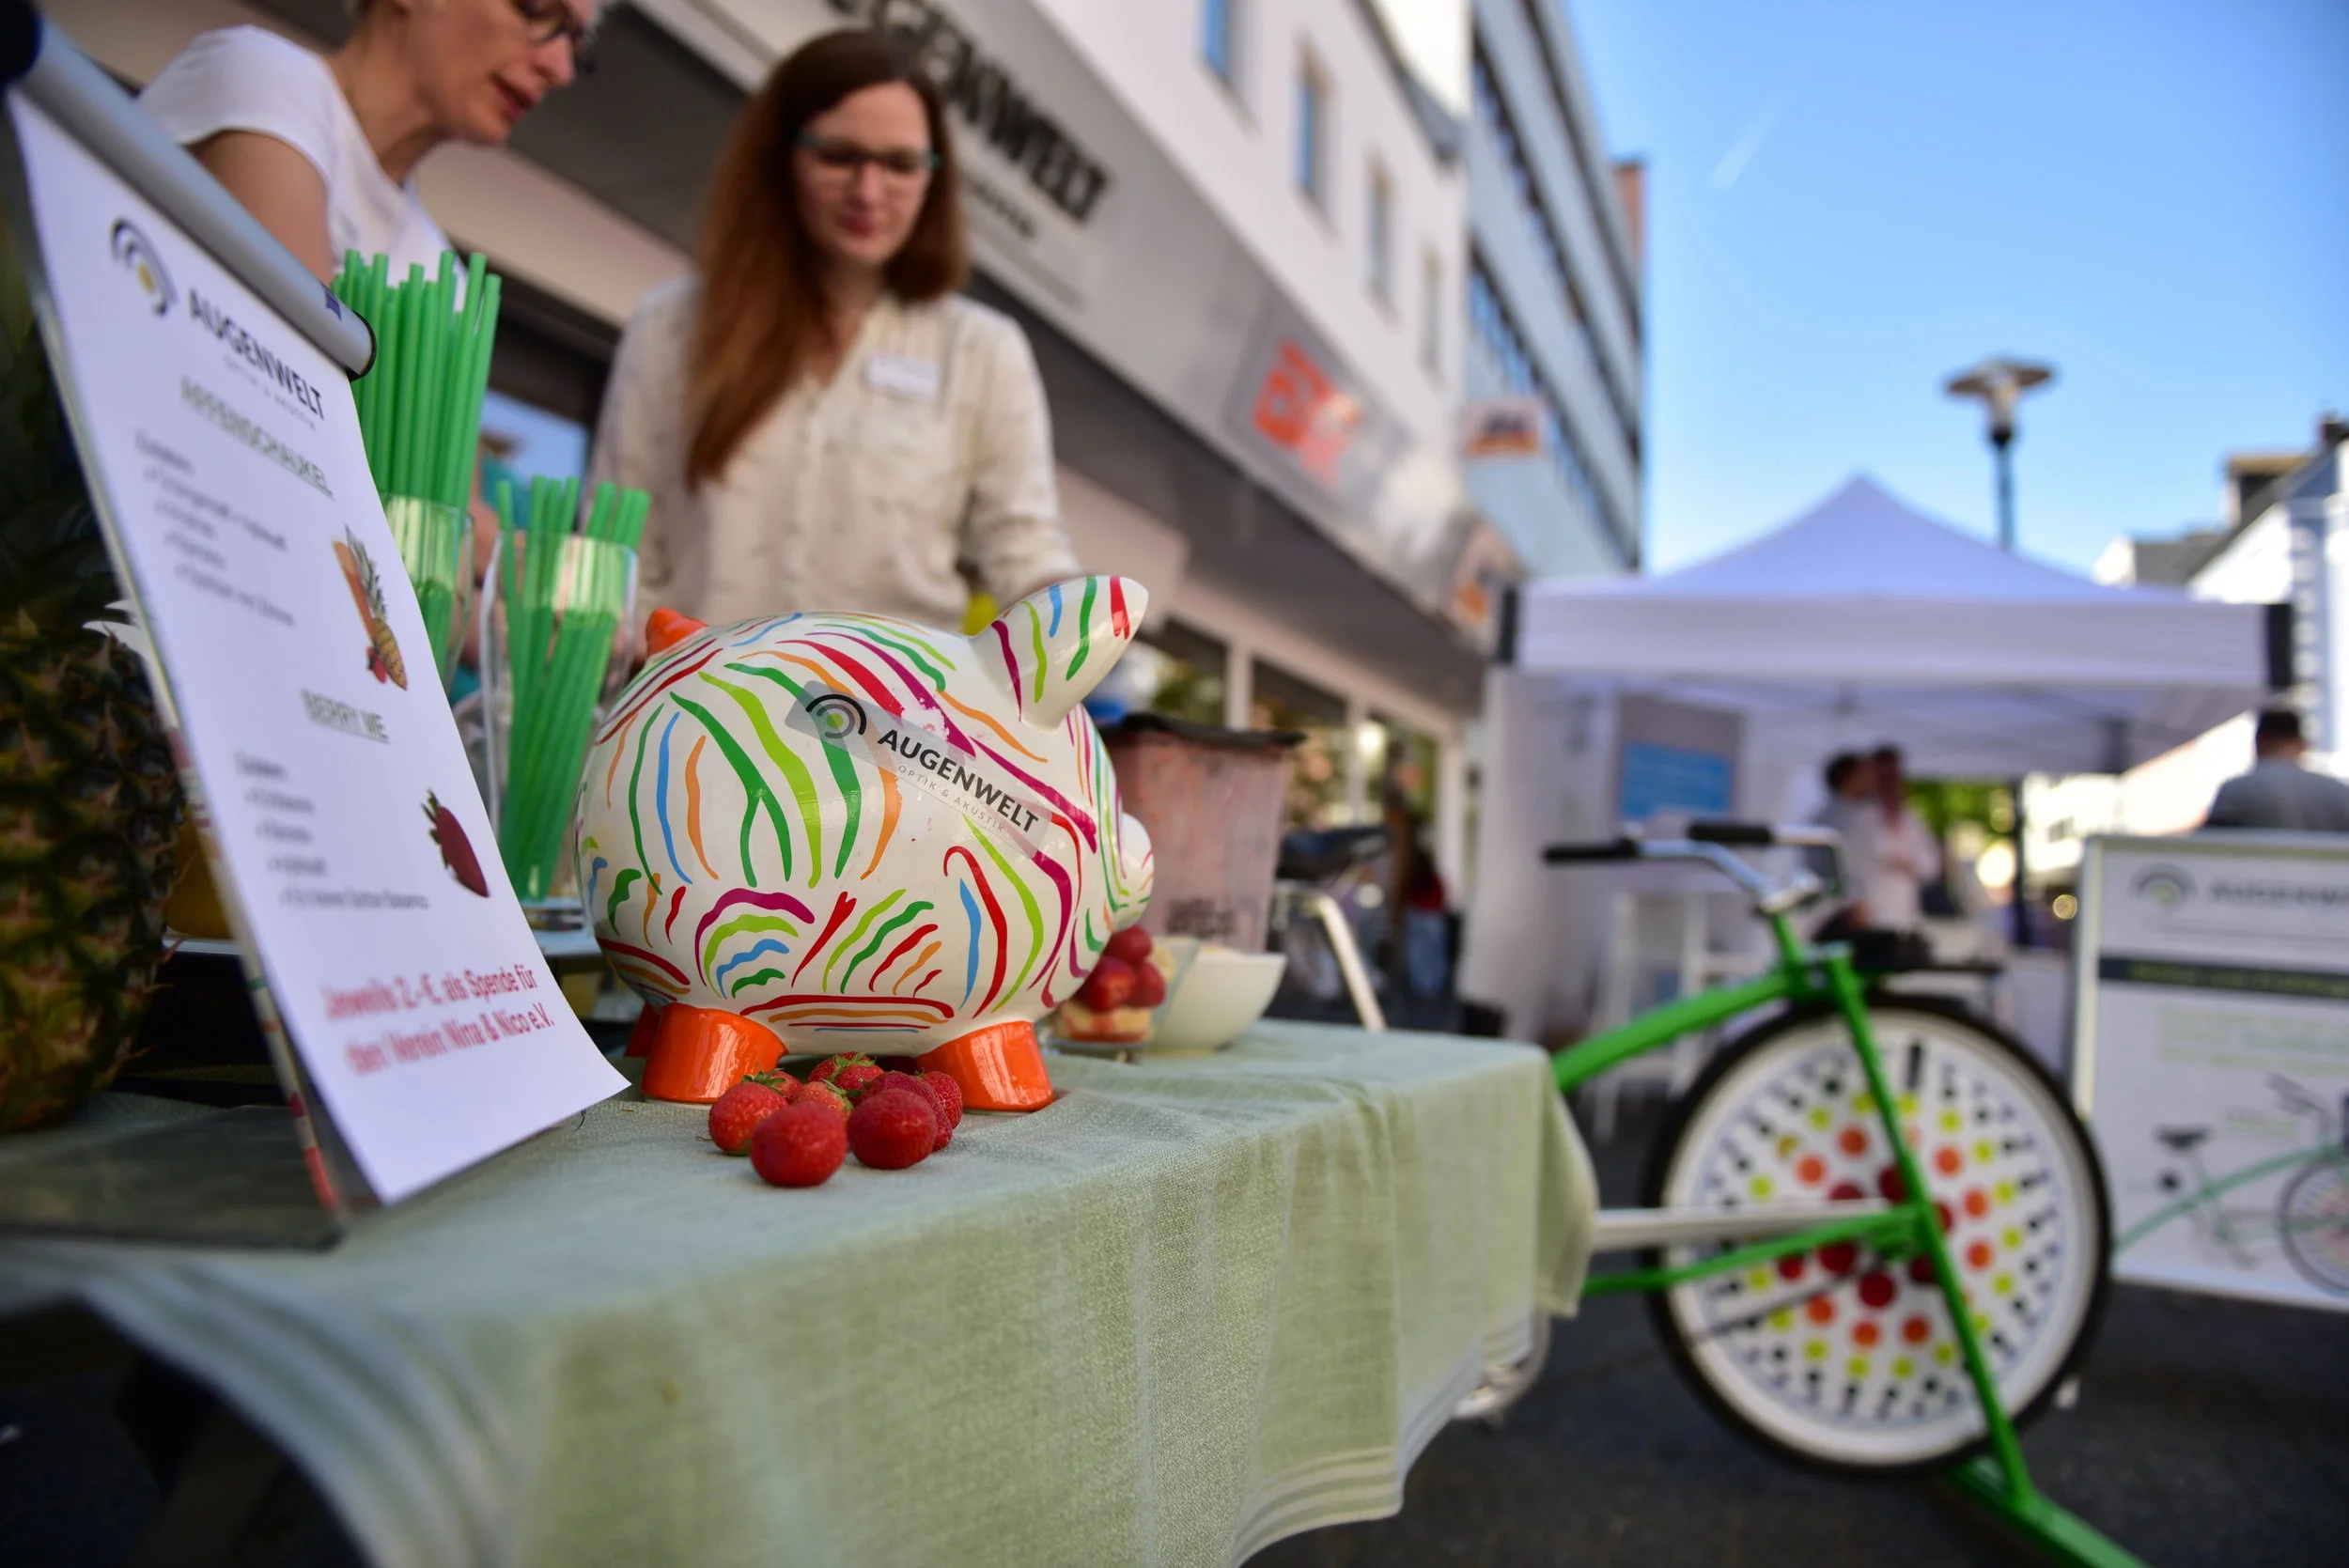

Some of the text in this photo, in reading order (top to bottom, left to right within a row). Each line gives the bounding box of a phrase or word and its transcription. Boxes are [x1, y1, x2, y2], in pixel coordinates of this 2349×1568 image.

[189, 287, 324, 420] AUGENWELT
[877, 728, 1039, 833] AUGENWELT
[898, 765, 1005, 833] OPTIK & AKUSTIK
[442, 971, 468, 1002] als
[463, 967, 518, 1003] Spende
[514, 964, 538, 990] für
[479, 1013, 500, 1041] &
[492, 1008, 531, 1038] Nico
[527, 1001, 555, 1030] e.V.
